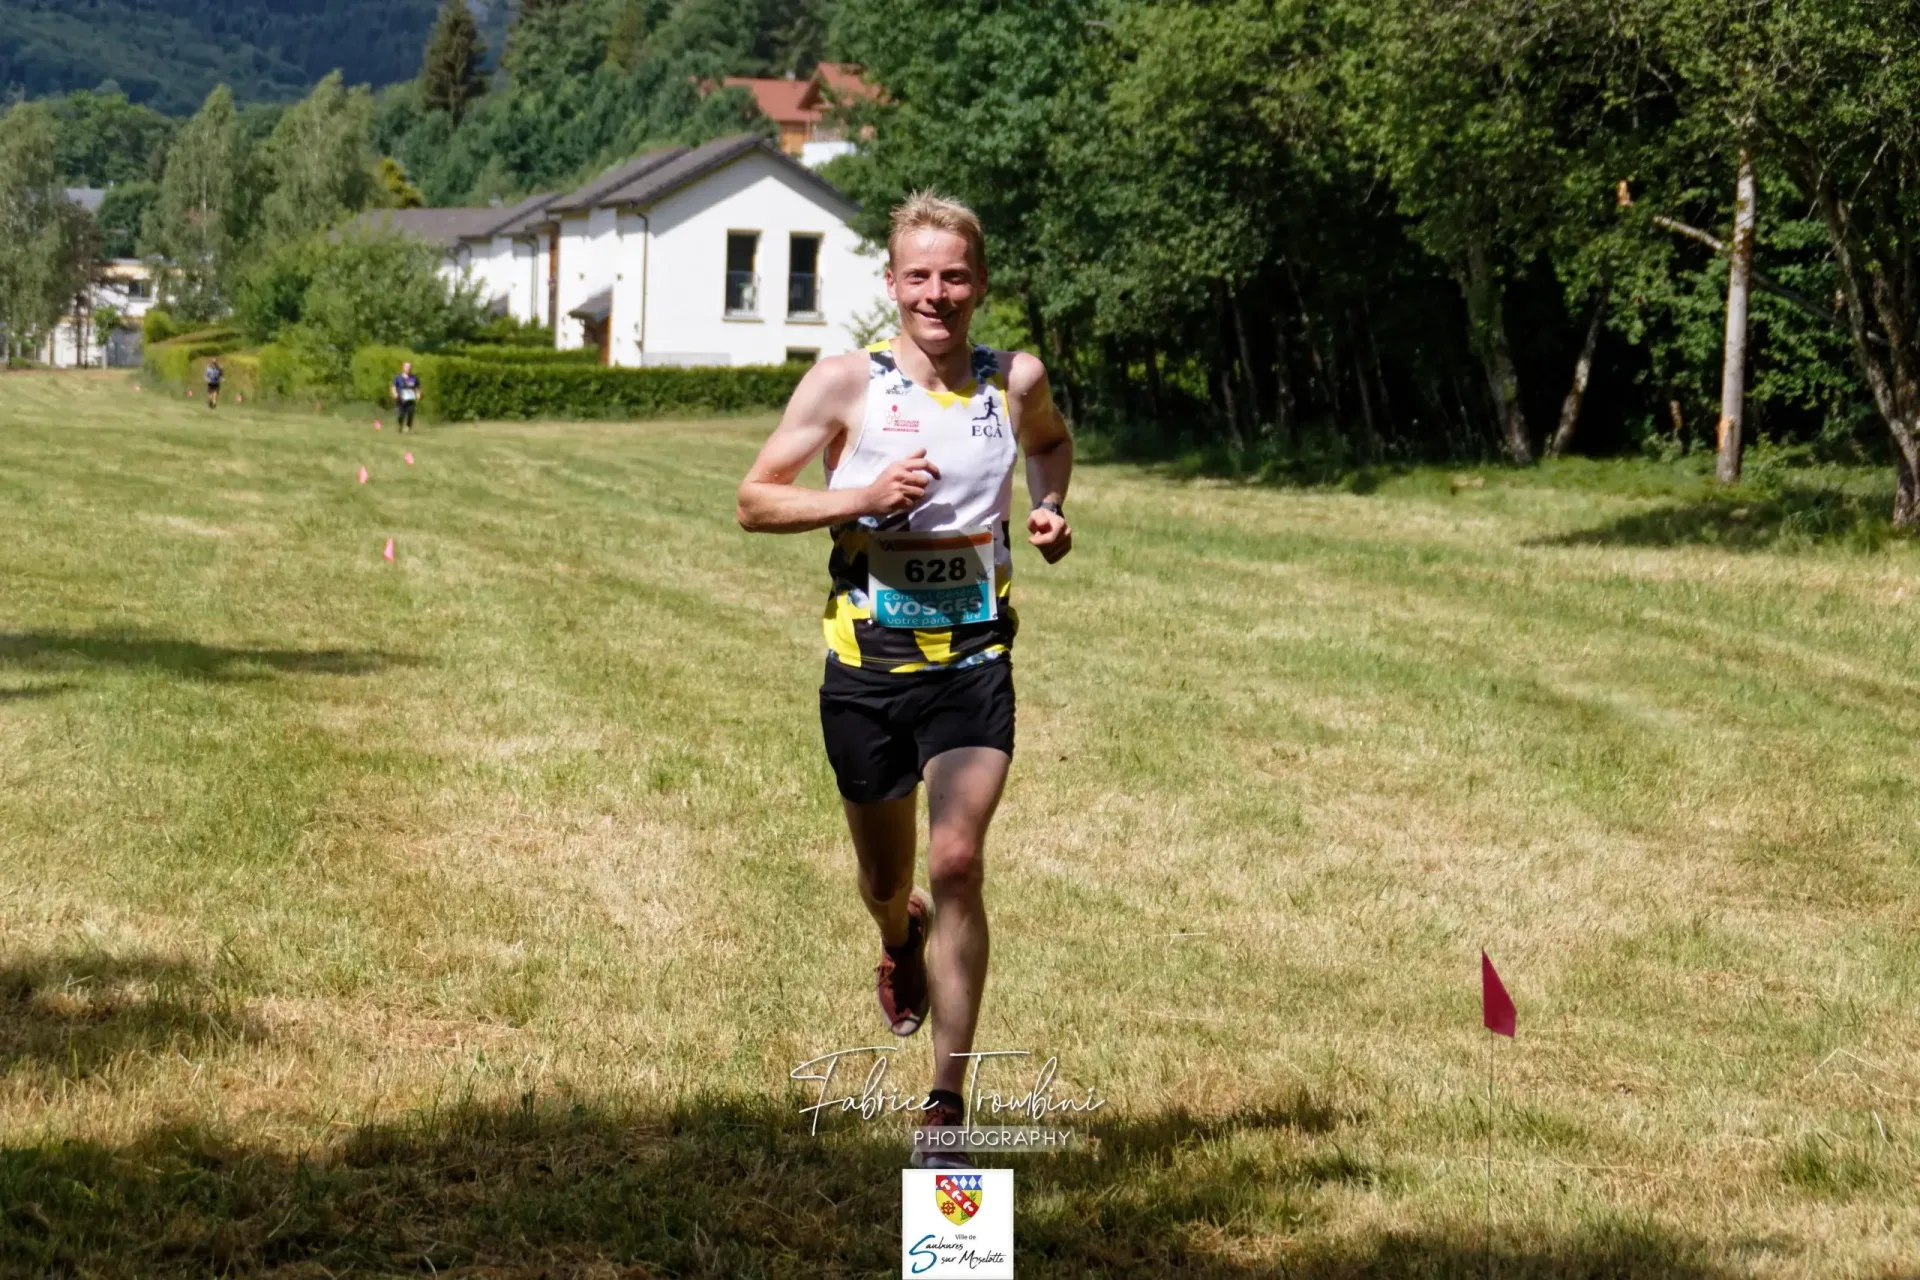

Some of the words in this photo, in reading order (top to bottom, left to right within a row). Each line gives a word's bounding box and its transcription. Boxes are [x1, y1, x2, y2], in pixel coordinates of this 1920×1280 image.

[971, 425, 1003, 438] ECA
[905, 557, 967, 583] 628
[883, 596, 983, 616] VOSGES
